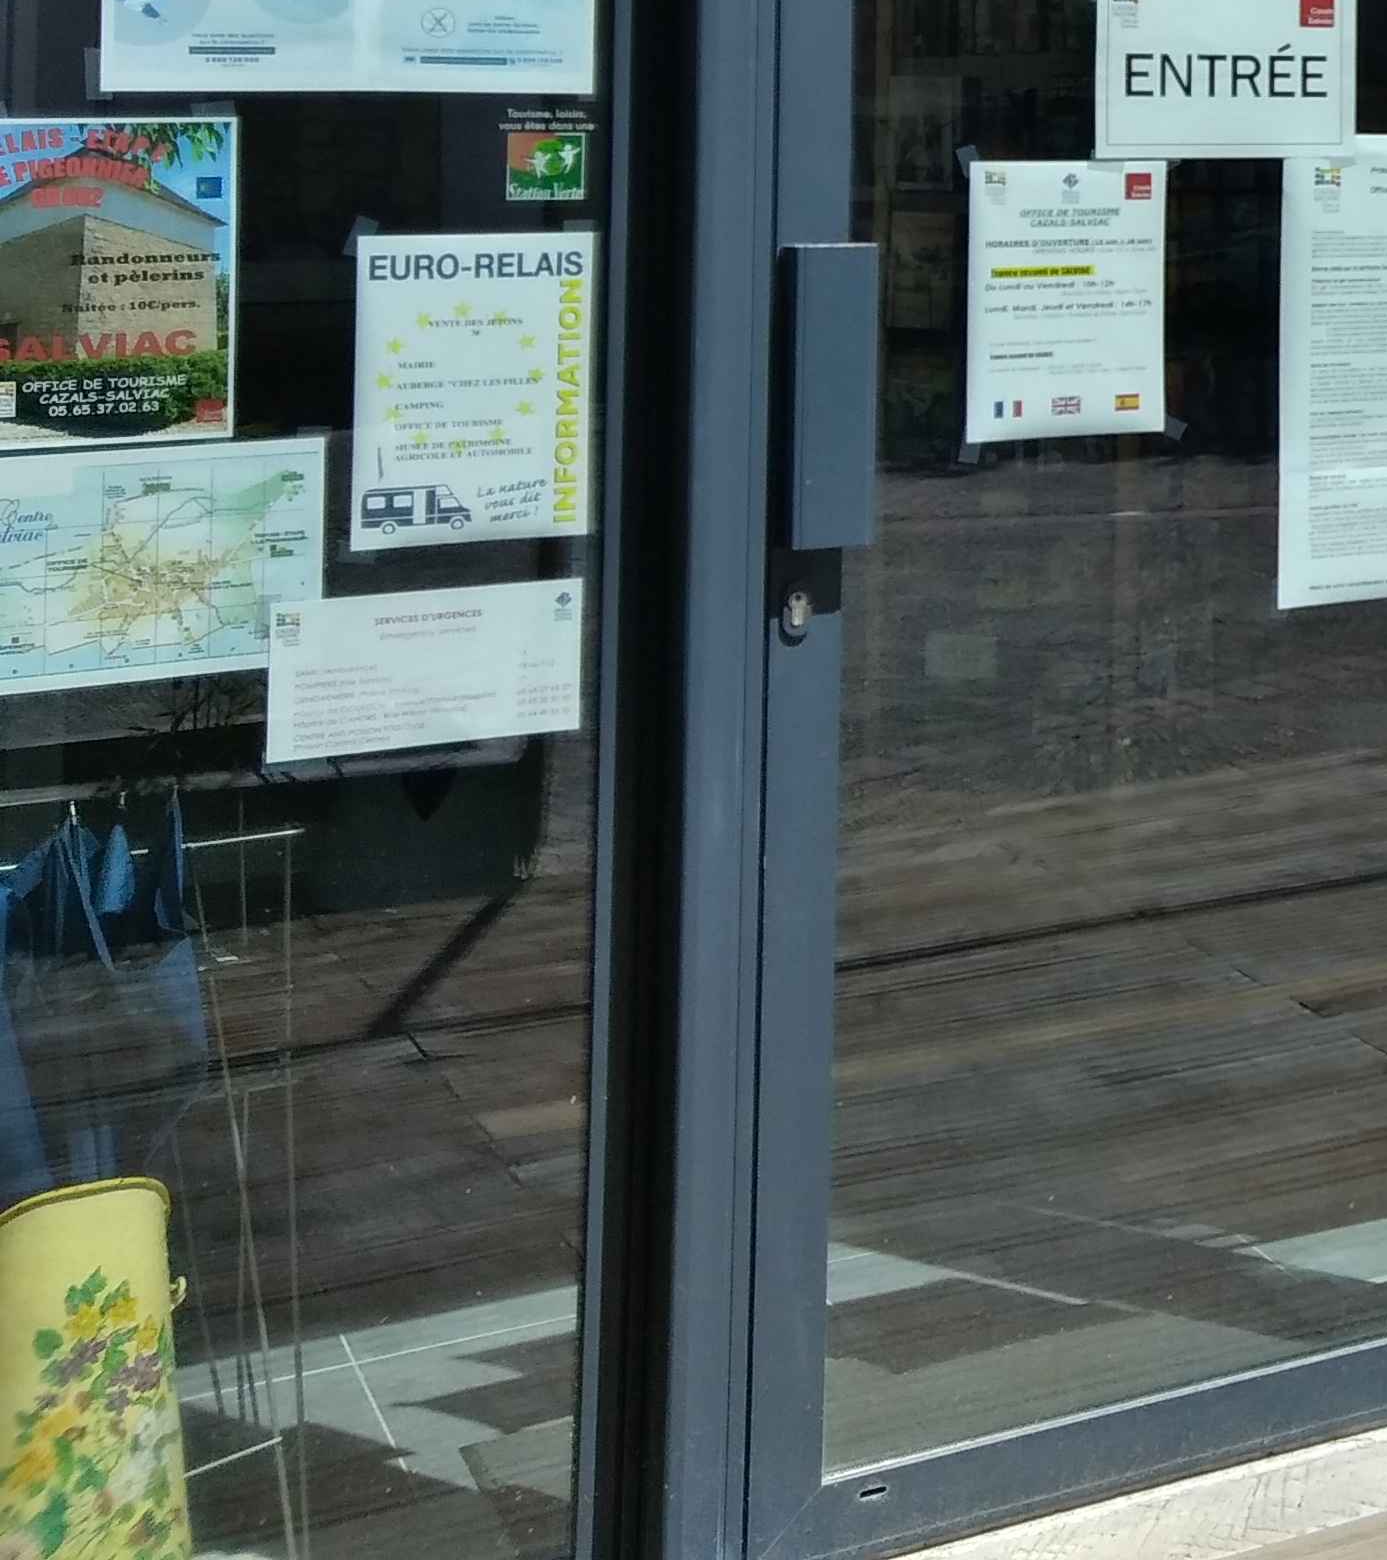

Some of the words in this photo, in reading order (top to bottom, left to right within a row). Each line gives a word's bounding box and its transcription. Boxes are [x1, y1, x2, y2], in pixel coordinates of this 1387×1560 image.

[1124, 42, 1328, 98] ENTRÉE
[498, 122, 523, 131] vous
[524, 121, 547, 131] êtes
[548, 122, 574, 131] dans
[575, 123, 596, 132] une
[70, 251, 221, 267] Randonneurs
[368, 250, 584, 282] EURO-RELAIS
[88, 271, 109, 285] et
[113, 270, 205, 287] pèlerins
[61, 302, 117, 314] Nuitée
[22, 378, 78, 393] OFFICE
[83, 378, 104, 390] DE
[108, 374, 188, 389] TOURISME
[39, 389, 170, 405] CAZALS-SALVIAC
[553, 279, 584, 524] INFORMATION
[48, 401, 160, 418] 05.65.37.02.63
[394, 401, 444, 412] CAMPING
[394, 421, 433, 432] OFFICE
[435, 420, 448, 430] DE
[500, 477, 548, 493] nature
[484, 496, 517, 512] vous
[489, 508, 533, 523] merci
